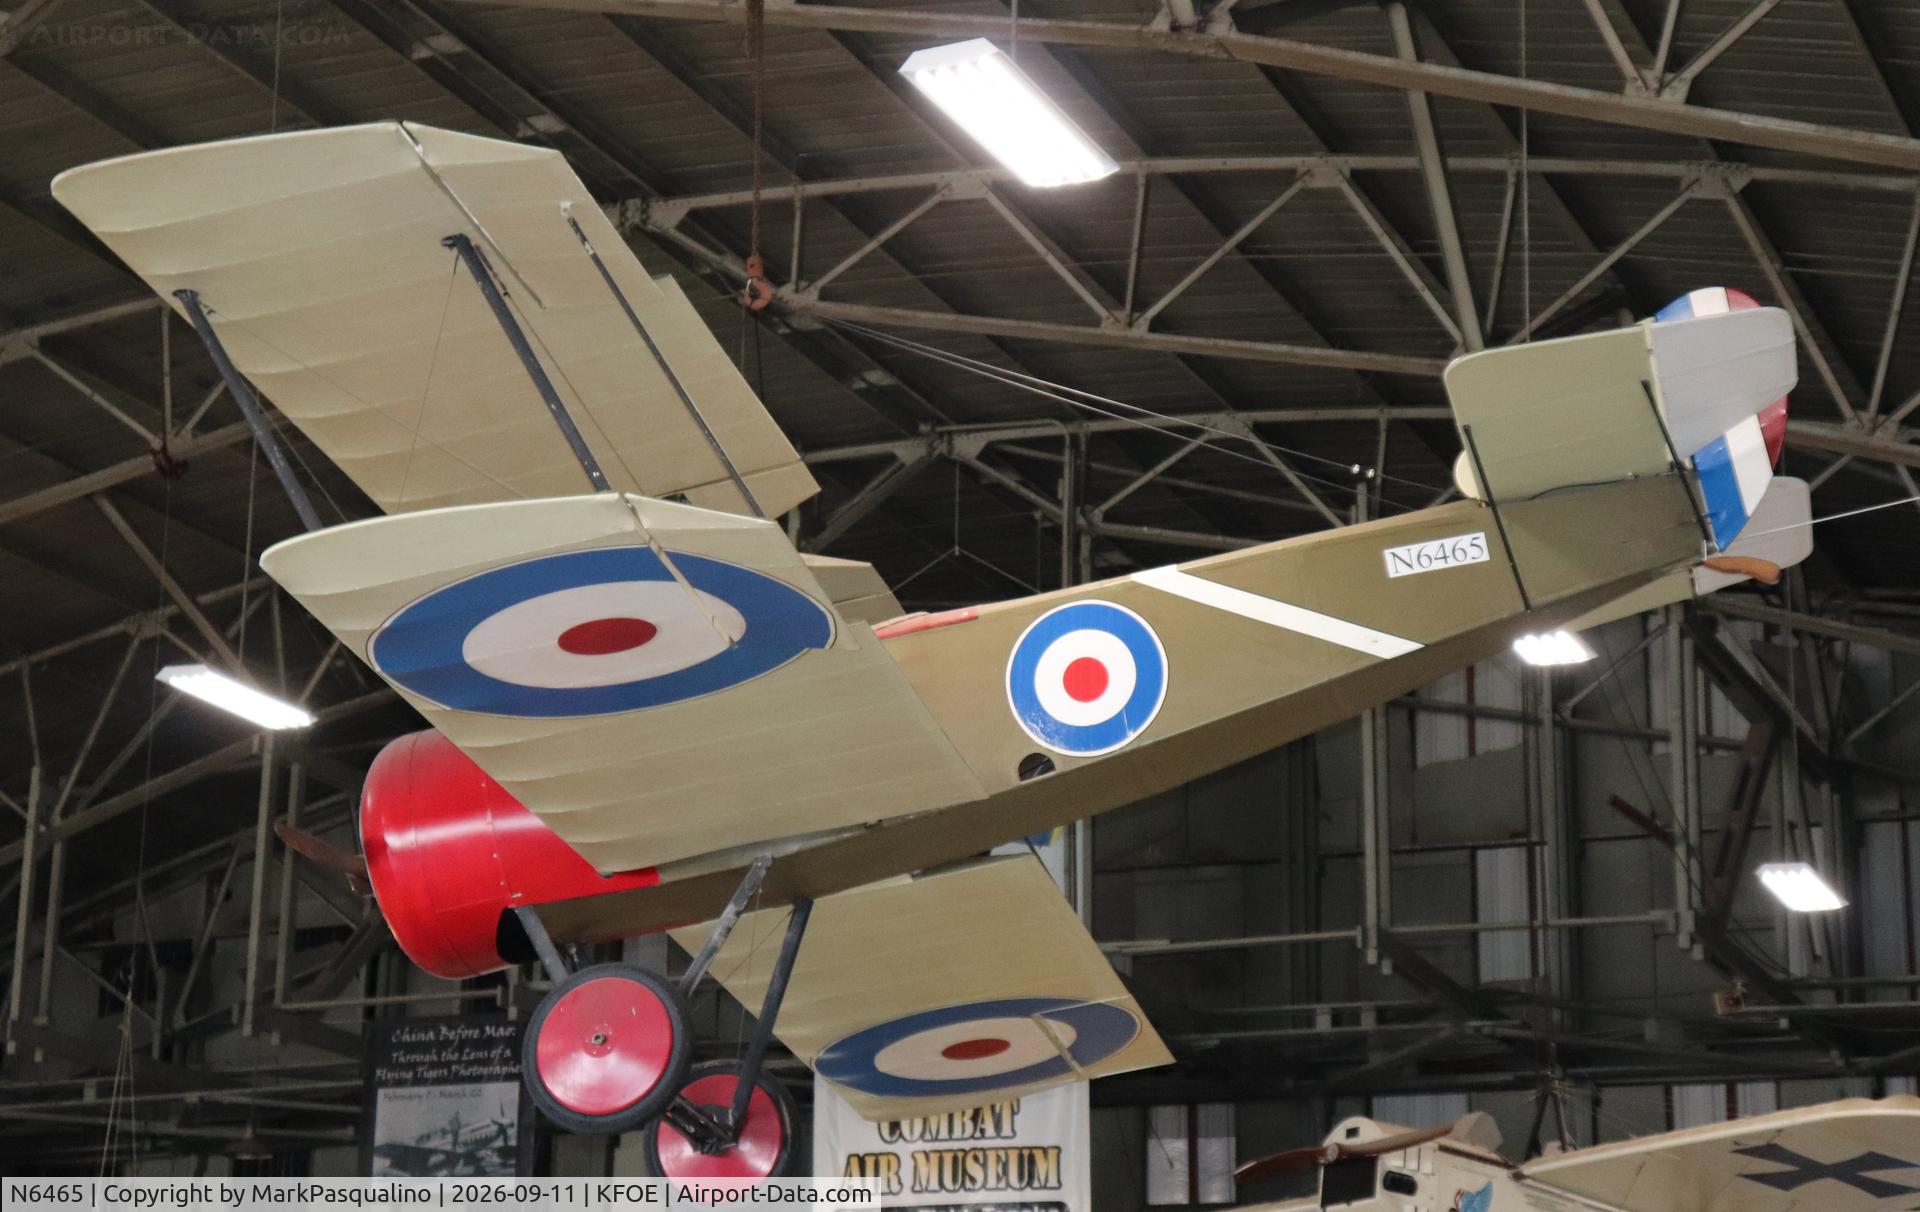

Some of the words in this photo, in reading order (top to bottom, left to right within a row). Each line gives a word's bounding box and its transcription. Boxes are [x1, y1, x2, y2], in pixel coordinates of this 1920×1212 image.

[1389, 536, 1485, 575] N6465
[391, 1026, 435, 1043] China
[439, 1024, 481, 1047] Before
[391, 1048, 438, 1066] Through
[440, 1048, 460, 1063] the
[462, 1047, 488, 1061] Lens
[489, 1045, 503, 1065] of
[504, 1048, 512, 1058] a
[375, 1068, 414, 1086] Flying
[416, 1065, 449, 1085] Tigers
[878, 1099, 1020, 1144] COMBAT
[842, 1152, 903, 1195] AIR
[911, 1146, 1062, 1192] MUSEUM
